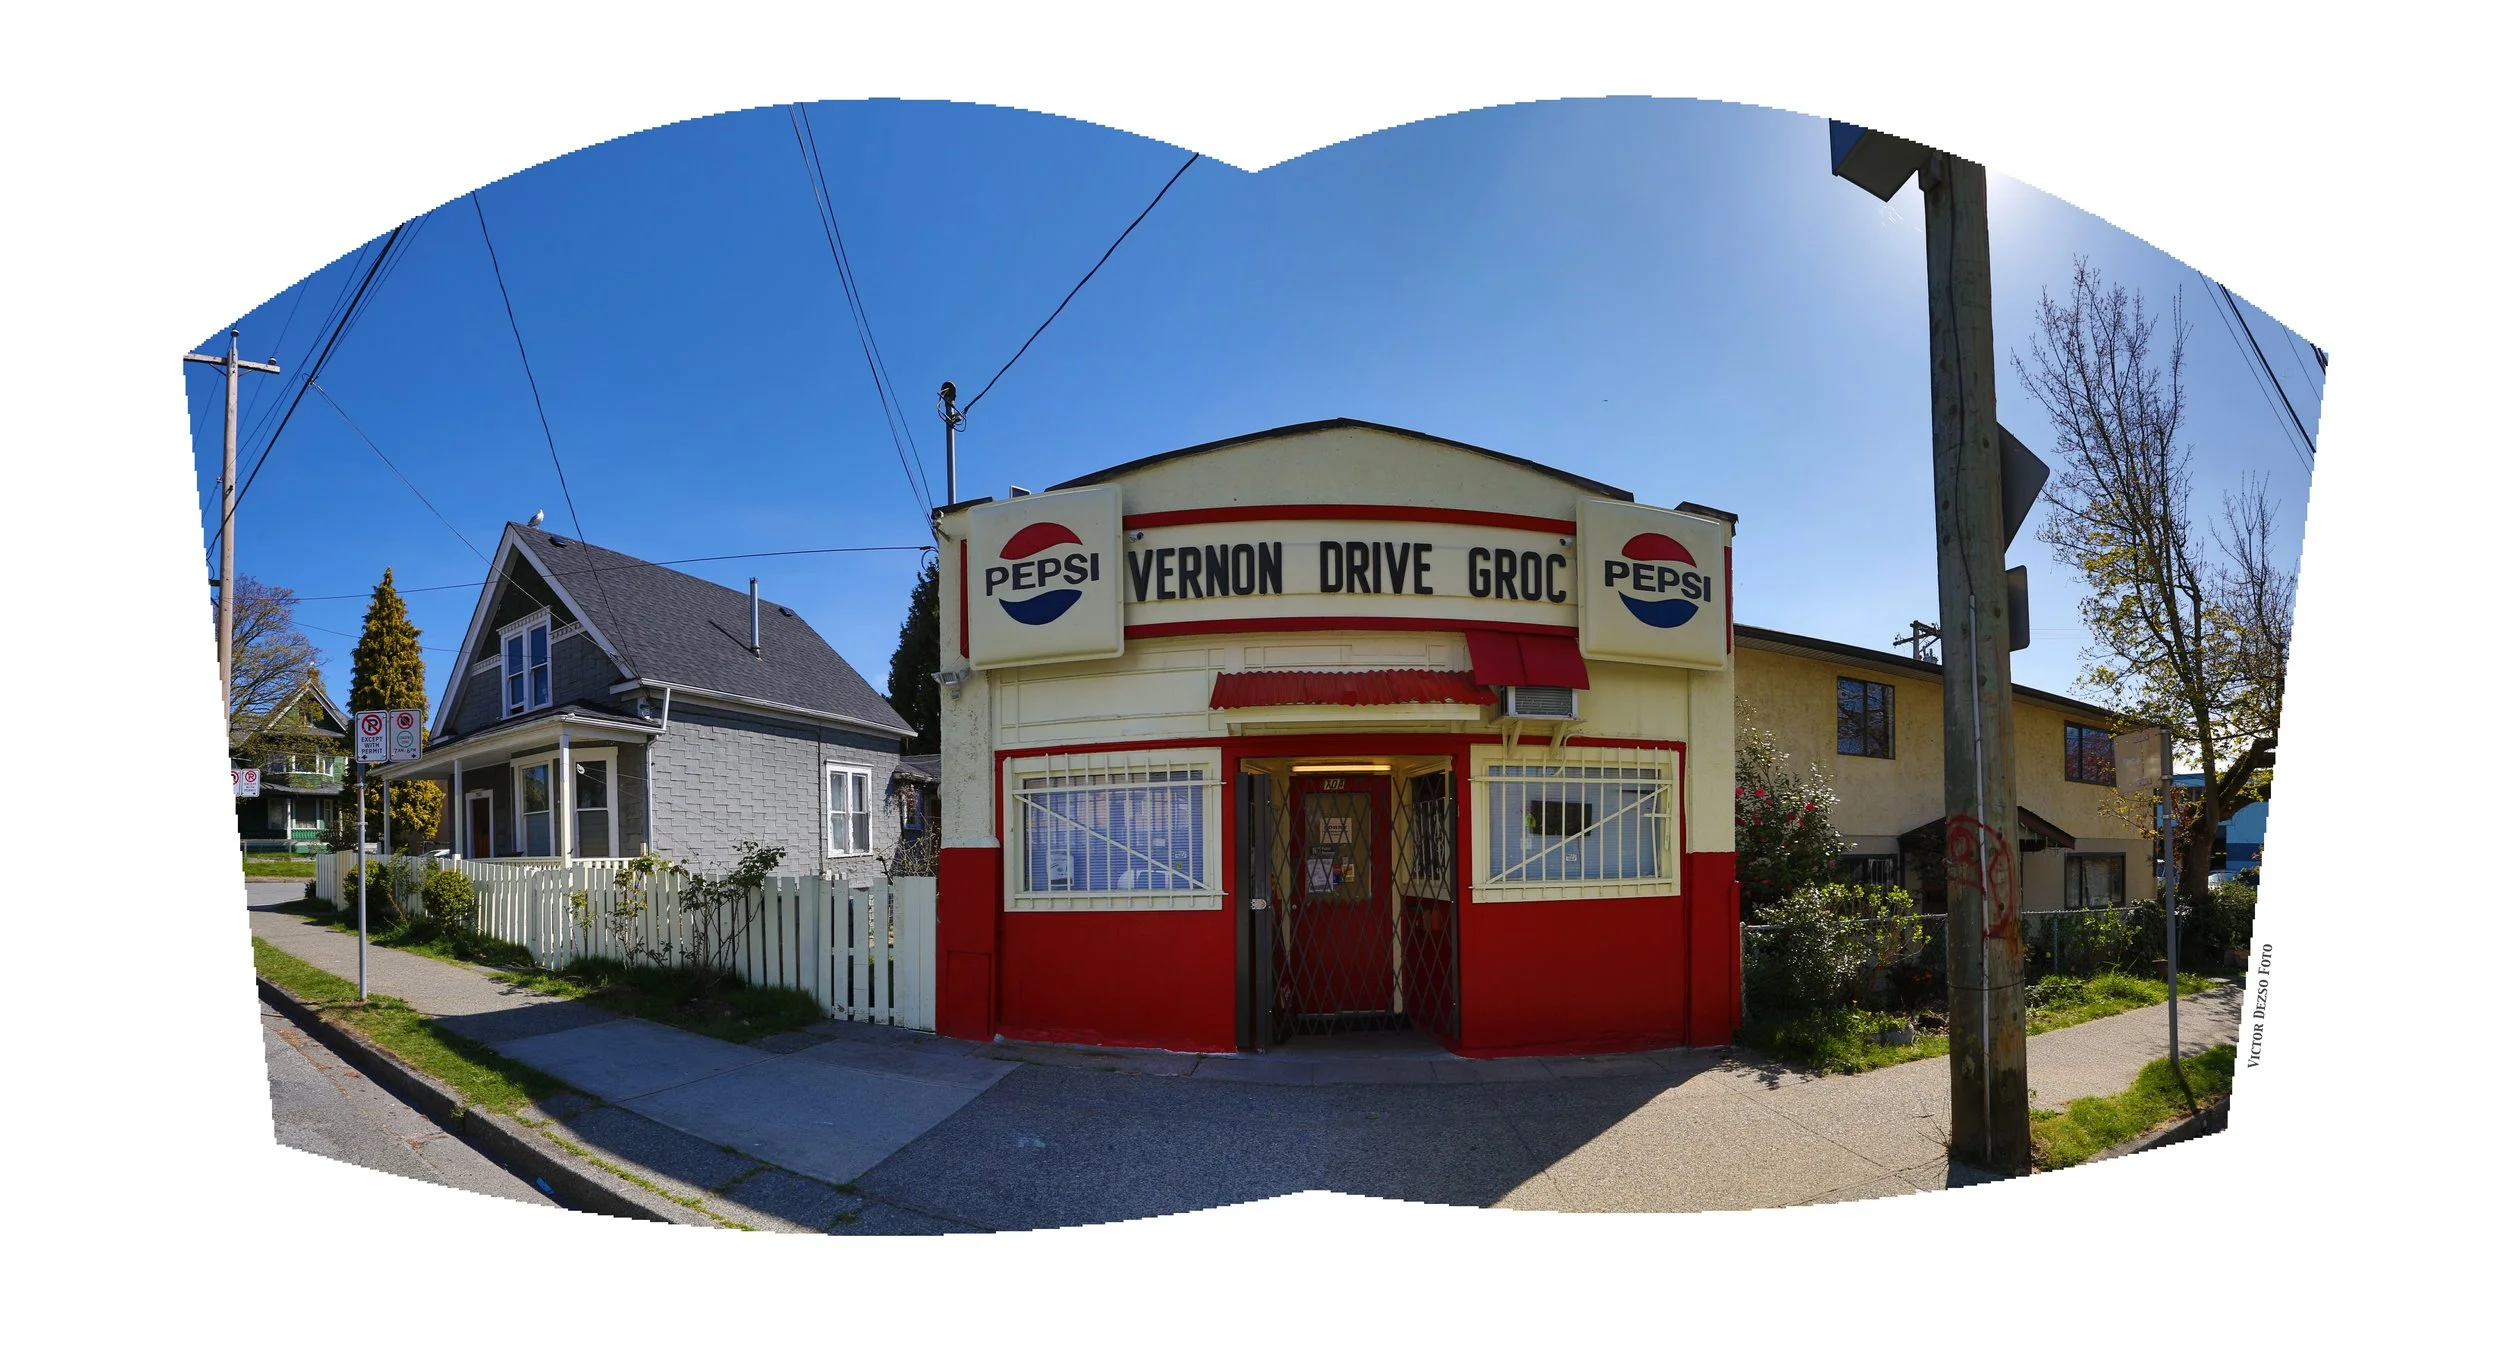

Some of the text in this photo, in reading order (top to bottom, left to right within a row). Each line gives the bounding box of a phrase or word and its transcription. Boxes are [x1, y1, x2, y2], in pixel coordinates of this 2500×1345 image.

[985, 552, 1100, 597] PEPSI
[1128, 540, 1567, 603] VERNON DRIVE GROC
[1604, 560, 1712, 602] PEPSI
